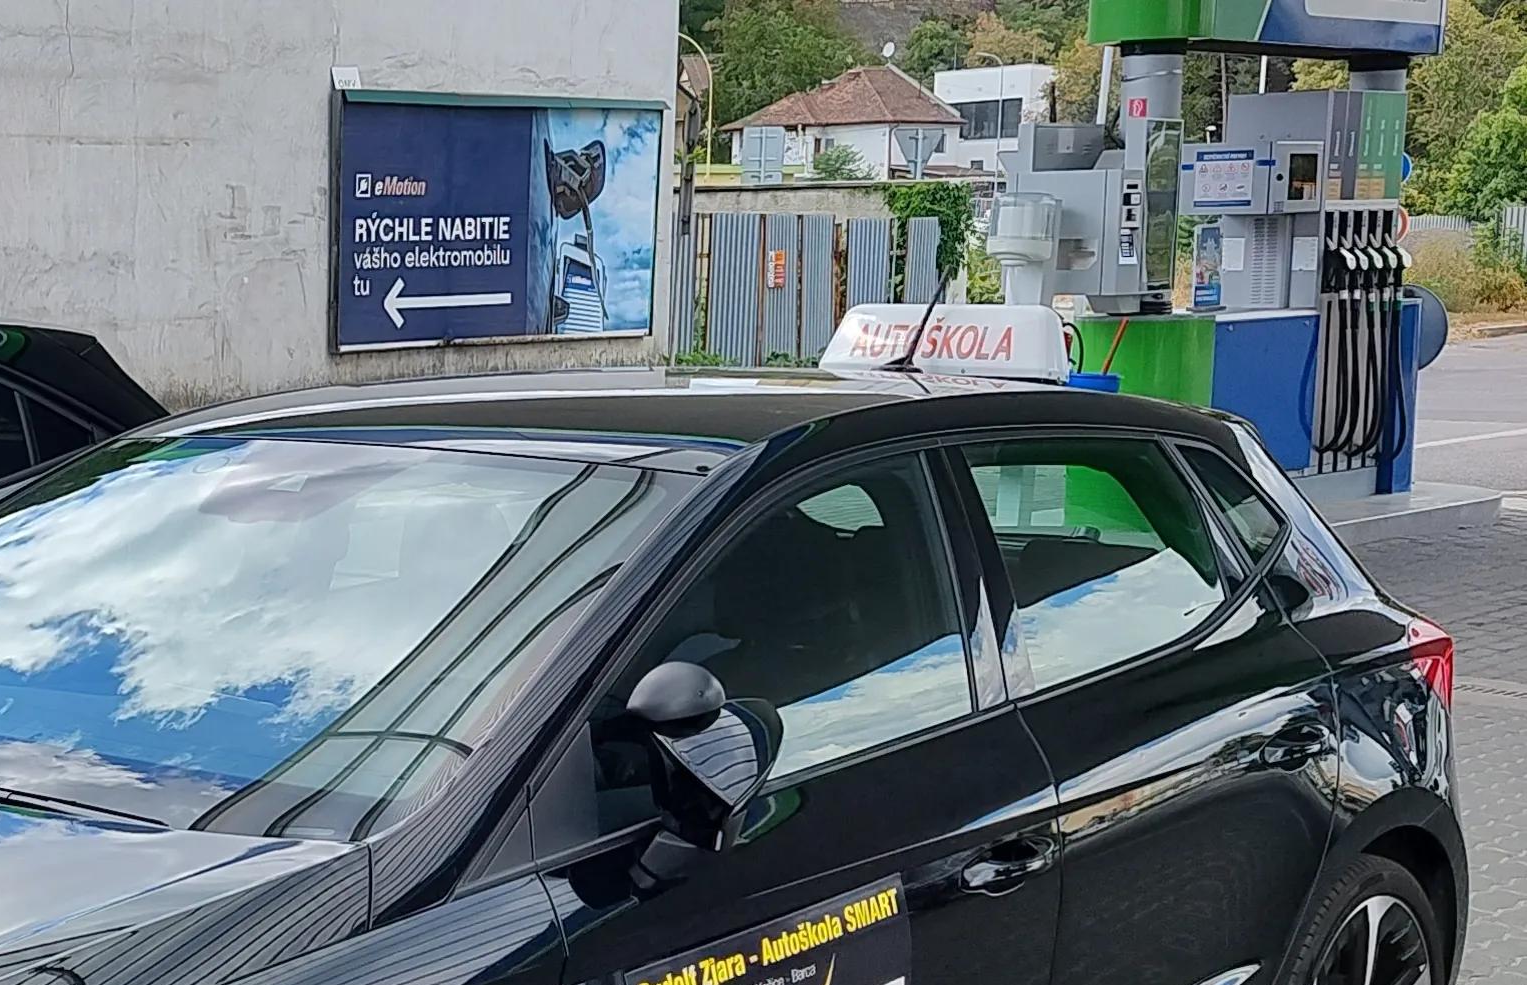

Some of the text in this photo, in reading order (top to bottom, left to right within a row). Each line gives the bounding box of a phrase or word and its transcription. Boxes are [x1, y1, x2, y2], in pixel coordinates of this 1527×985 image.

[375, 176, 427, 196] eMotion
[354, 211, 511, 243] RÝCHLE NABITIE
[353, 244, 511, 270] vášho elektromobilu
[353, 274, 370, 296] tu
[760, 914, 843, 967] Autoškola
[844, 887, 900, 933] SMART
[790, 963, 817, 984] Barca
